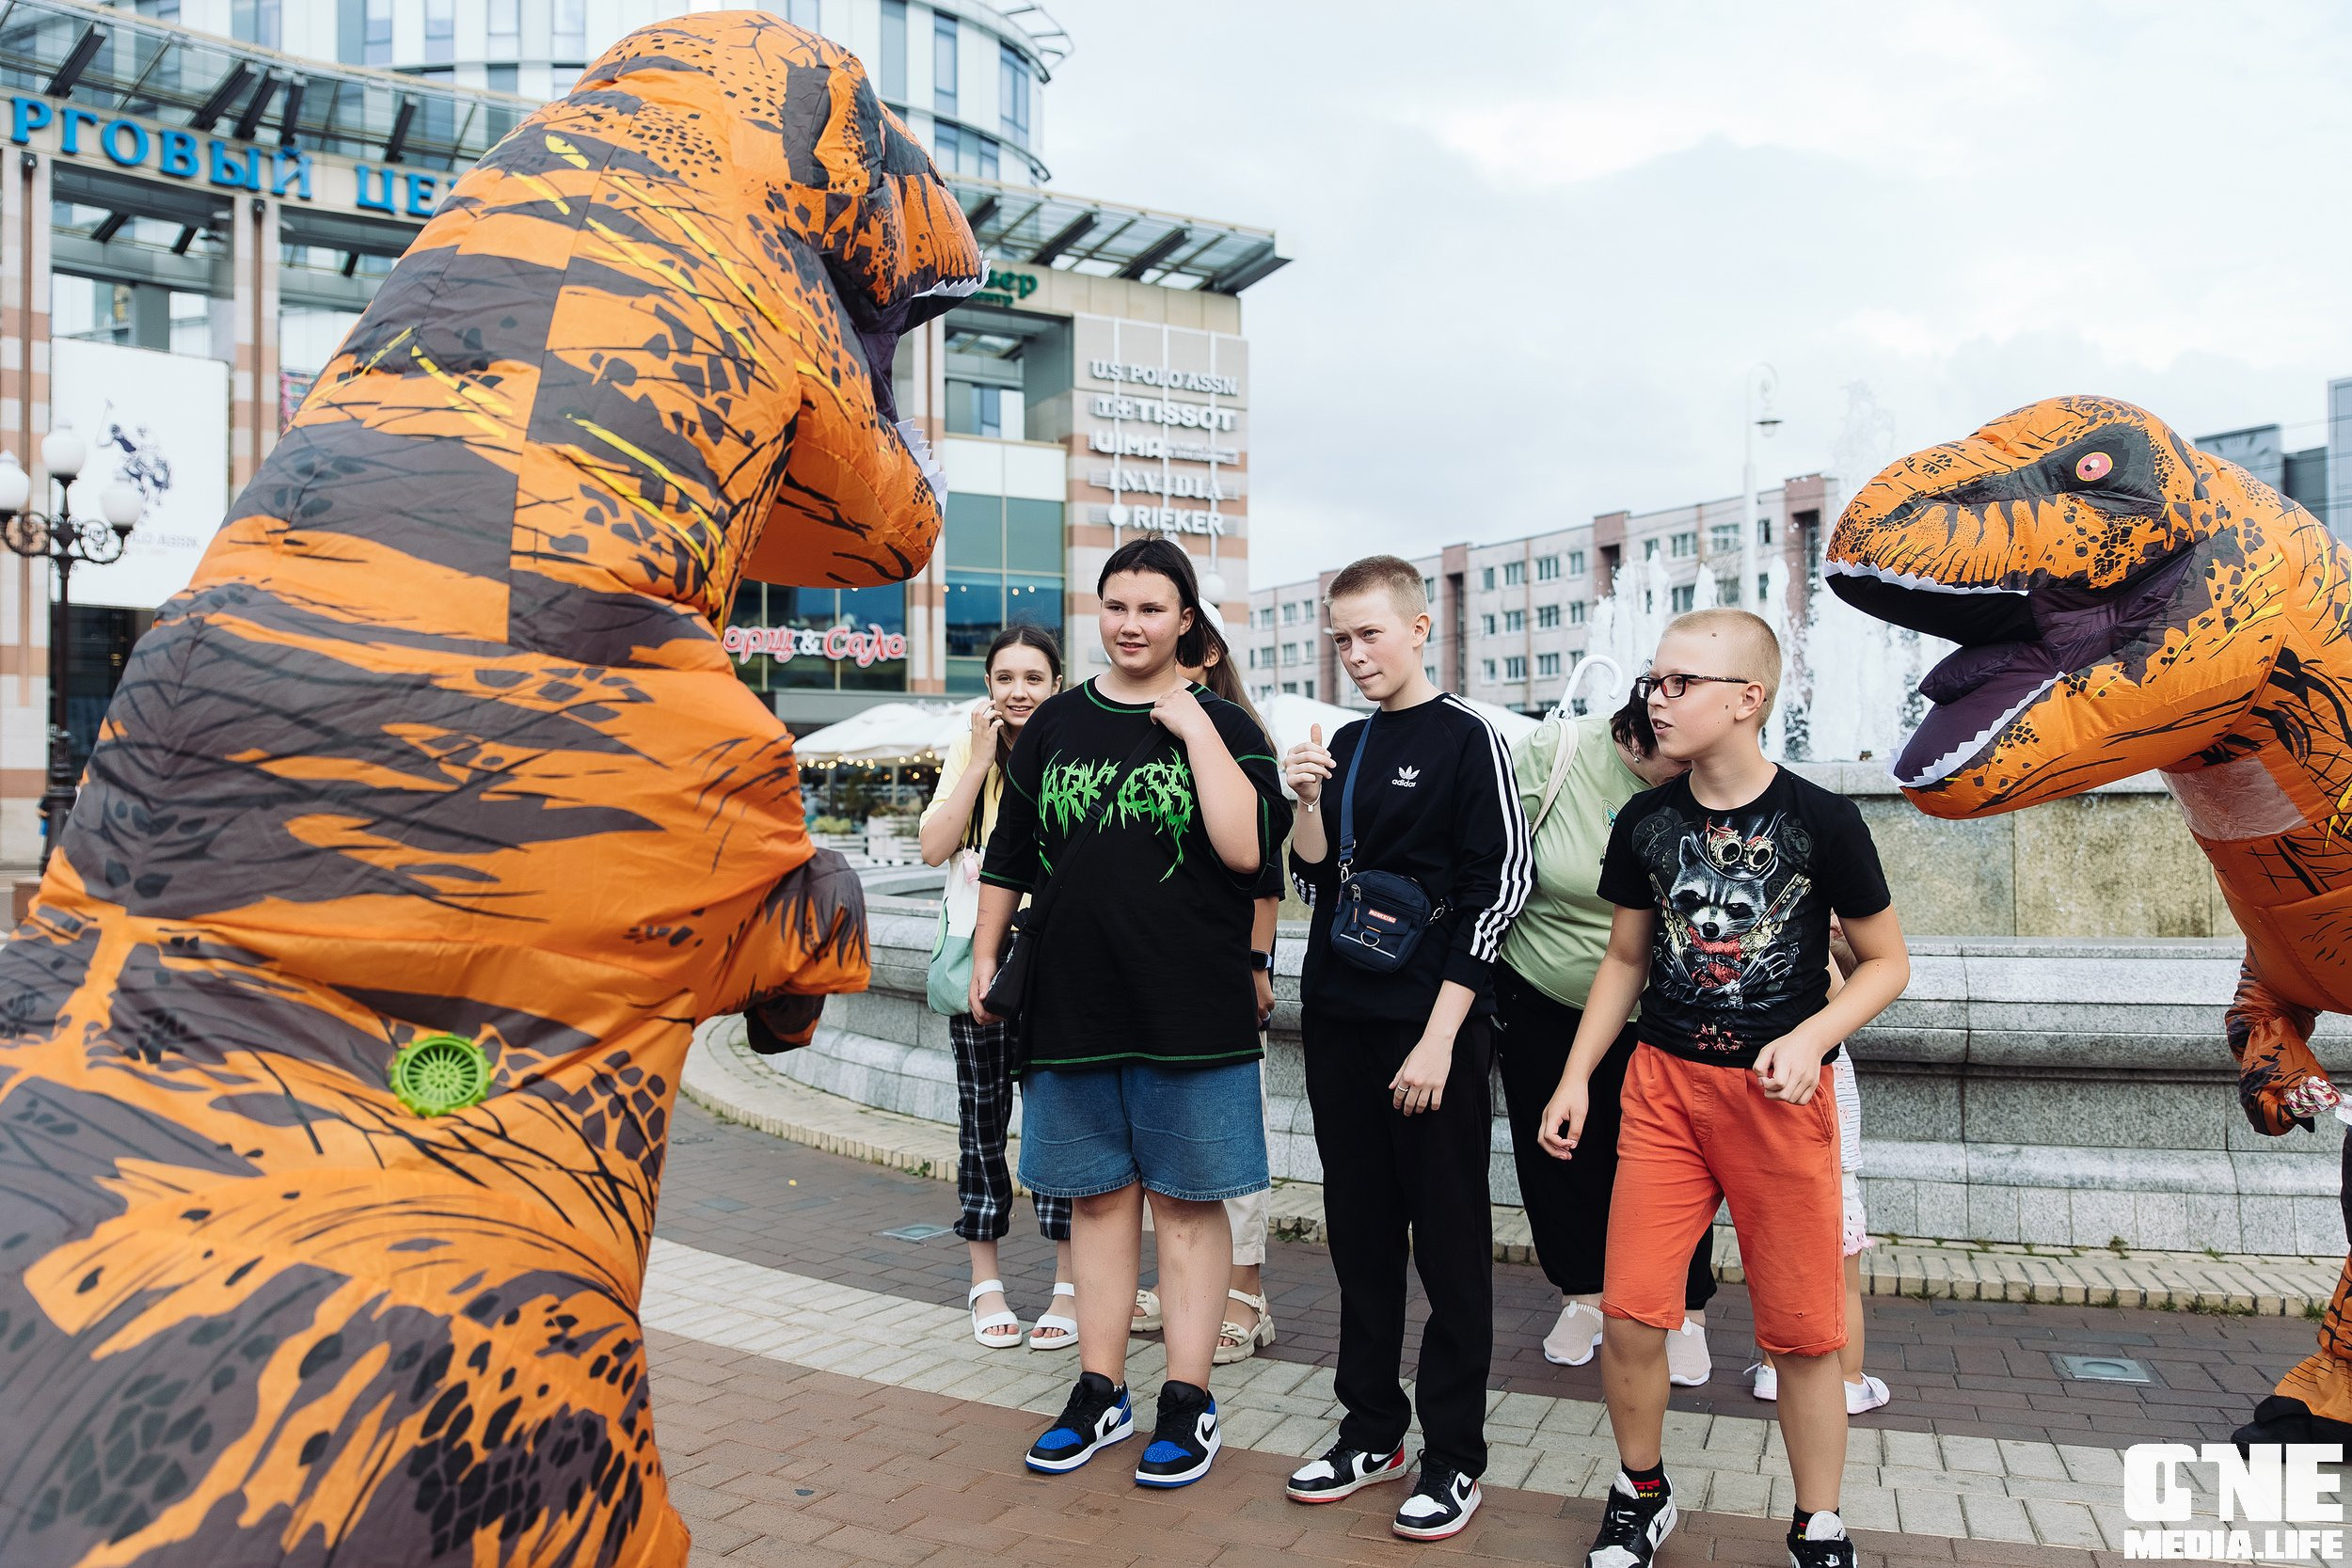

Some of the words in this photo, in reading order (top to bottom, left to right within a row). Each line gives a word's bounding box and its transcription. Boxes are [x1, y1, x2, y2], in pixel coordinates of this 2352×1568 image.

[10, 96, 313, 198] РГОВЫЙ
[355, 164, 458, 216] ЦЕ
[1130, 363, 1184, 388] POLO
[1135, 398, 1238, 431] TISSOT
[1133, 505, 1225, 535] RIEKER
[723, 625, 795, 664] орщ
[800, 628, 820, 656] &
[822, 623, 906, 668] Сало
[1391, 779, 1417, 787] adidas
